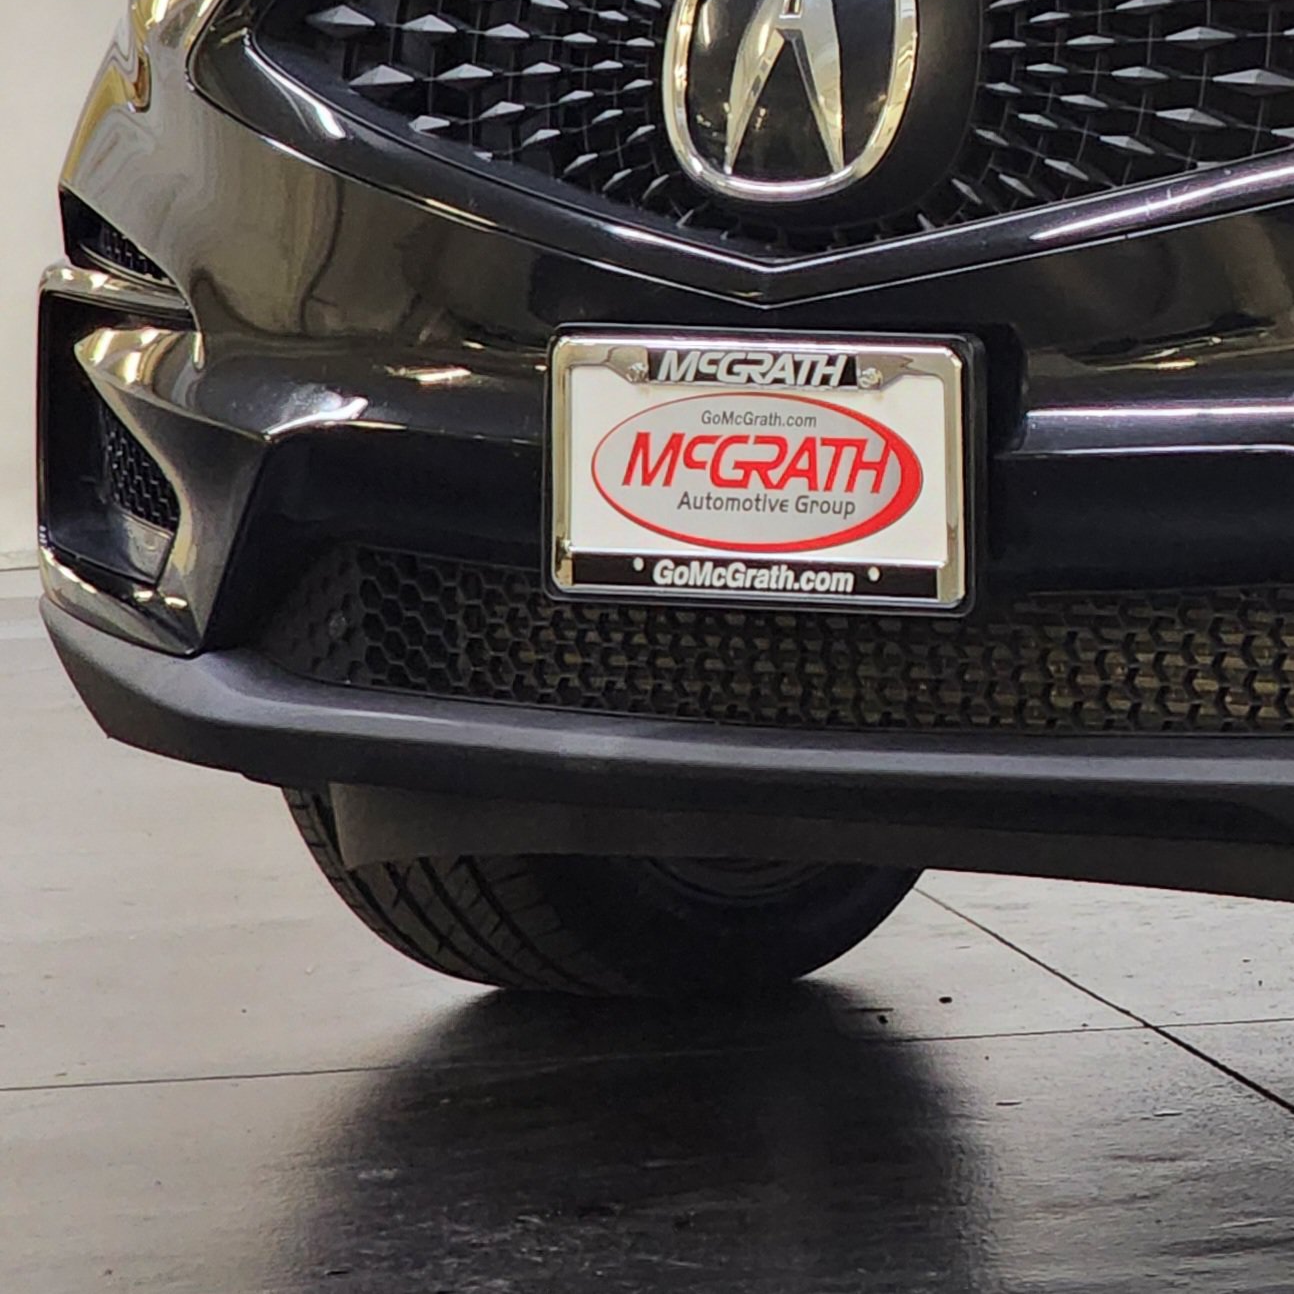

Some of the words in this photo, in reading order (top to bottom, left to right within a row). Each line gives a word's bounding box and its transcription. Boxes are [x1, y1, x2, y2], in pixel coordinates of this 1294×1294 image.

[657, 349, 846, 387] McGRATH
[700, 409, 818, 428] GoMcGrath.com
[621, 431, 893, 494] McGRATH
[676, 490, 789, 513] Automotive
[794, 495, 856, 520] Group
[652, 558, 855, 593] GoMcGrath.com
